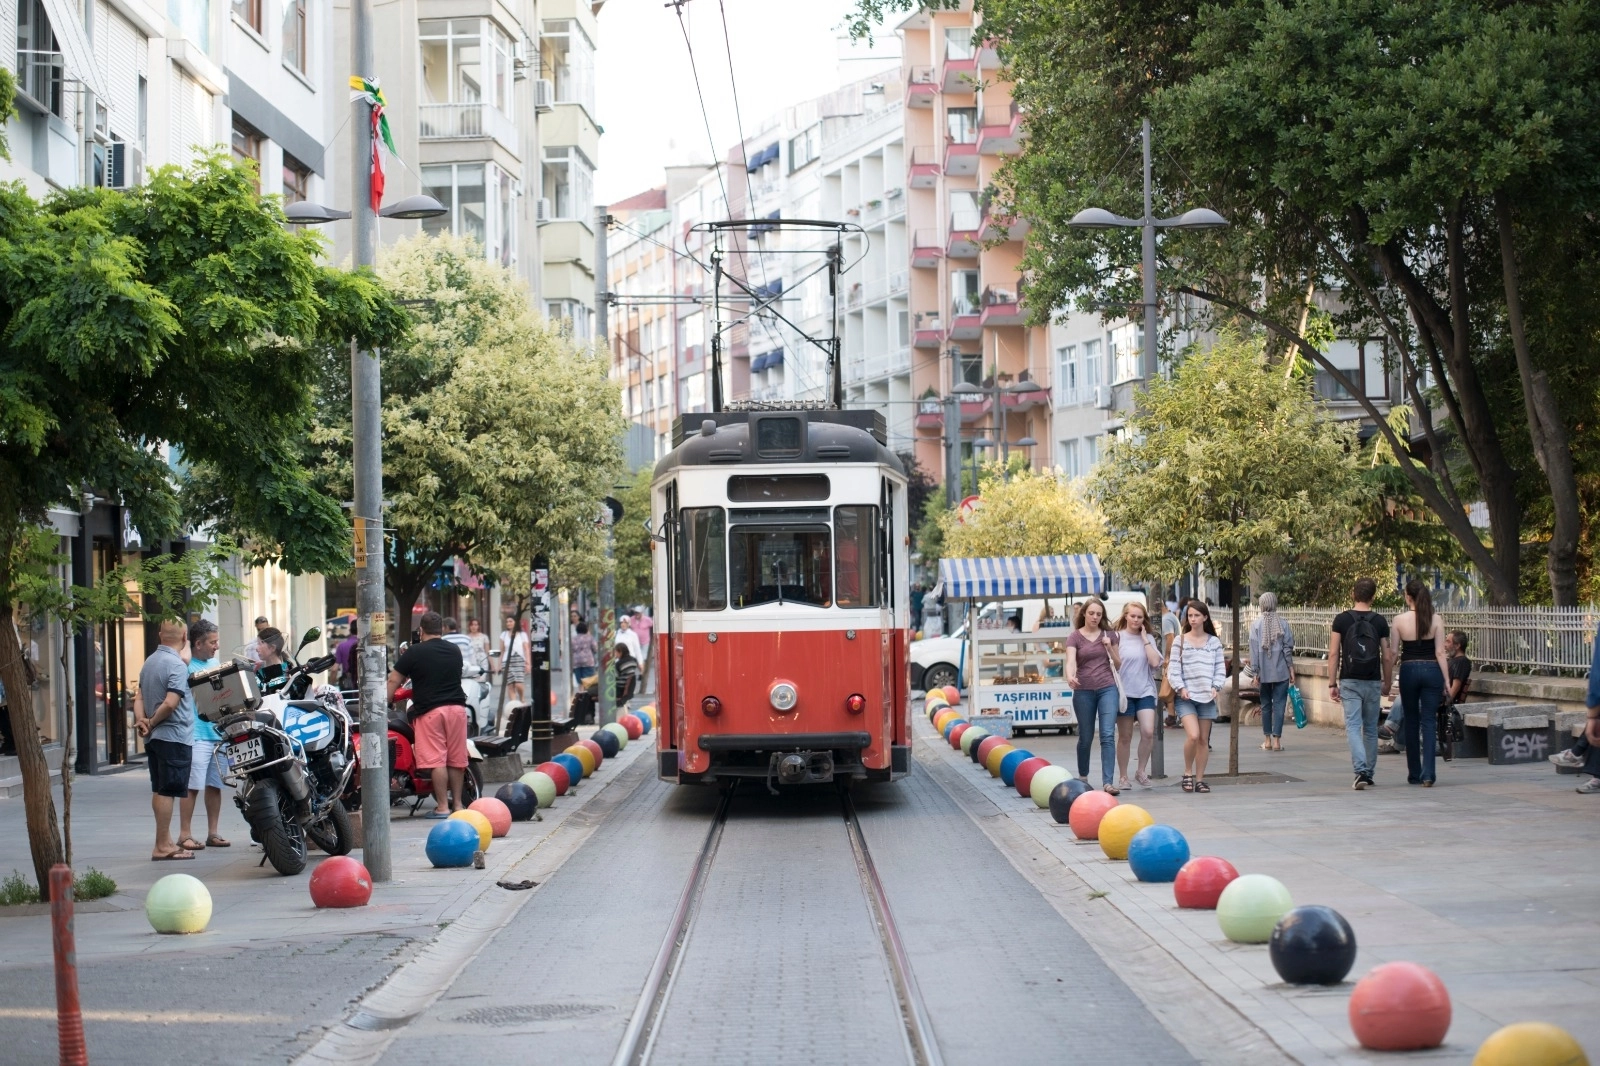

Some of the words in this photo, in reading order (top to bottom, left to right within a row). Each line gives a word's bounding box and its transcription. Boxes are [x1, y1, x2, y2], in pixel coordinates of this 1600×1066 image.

[994, 691, 1052, 704] TAŞFIRIN
[228, 746, 240, 756] 34
[247, 739, 260, 749] UA
[236, 749, 259, 762] 3771
